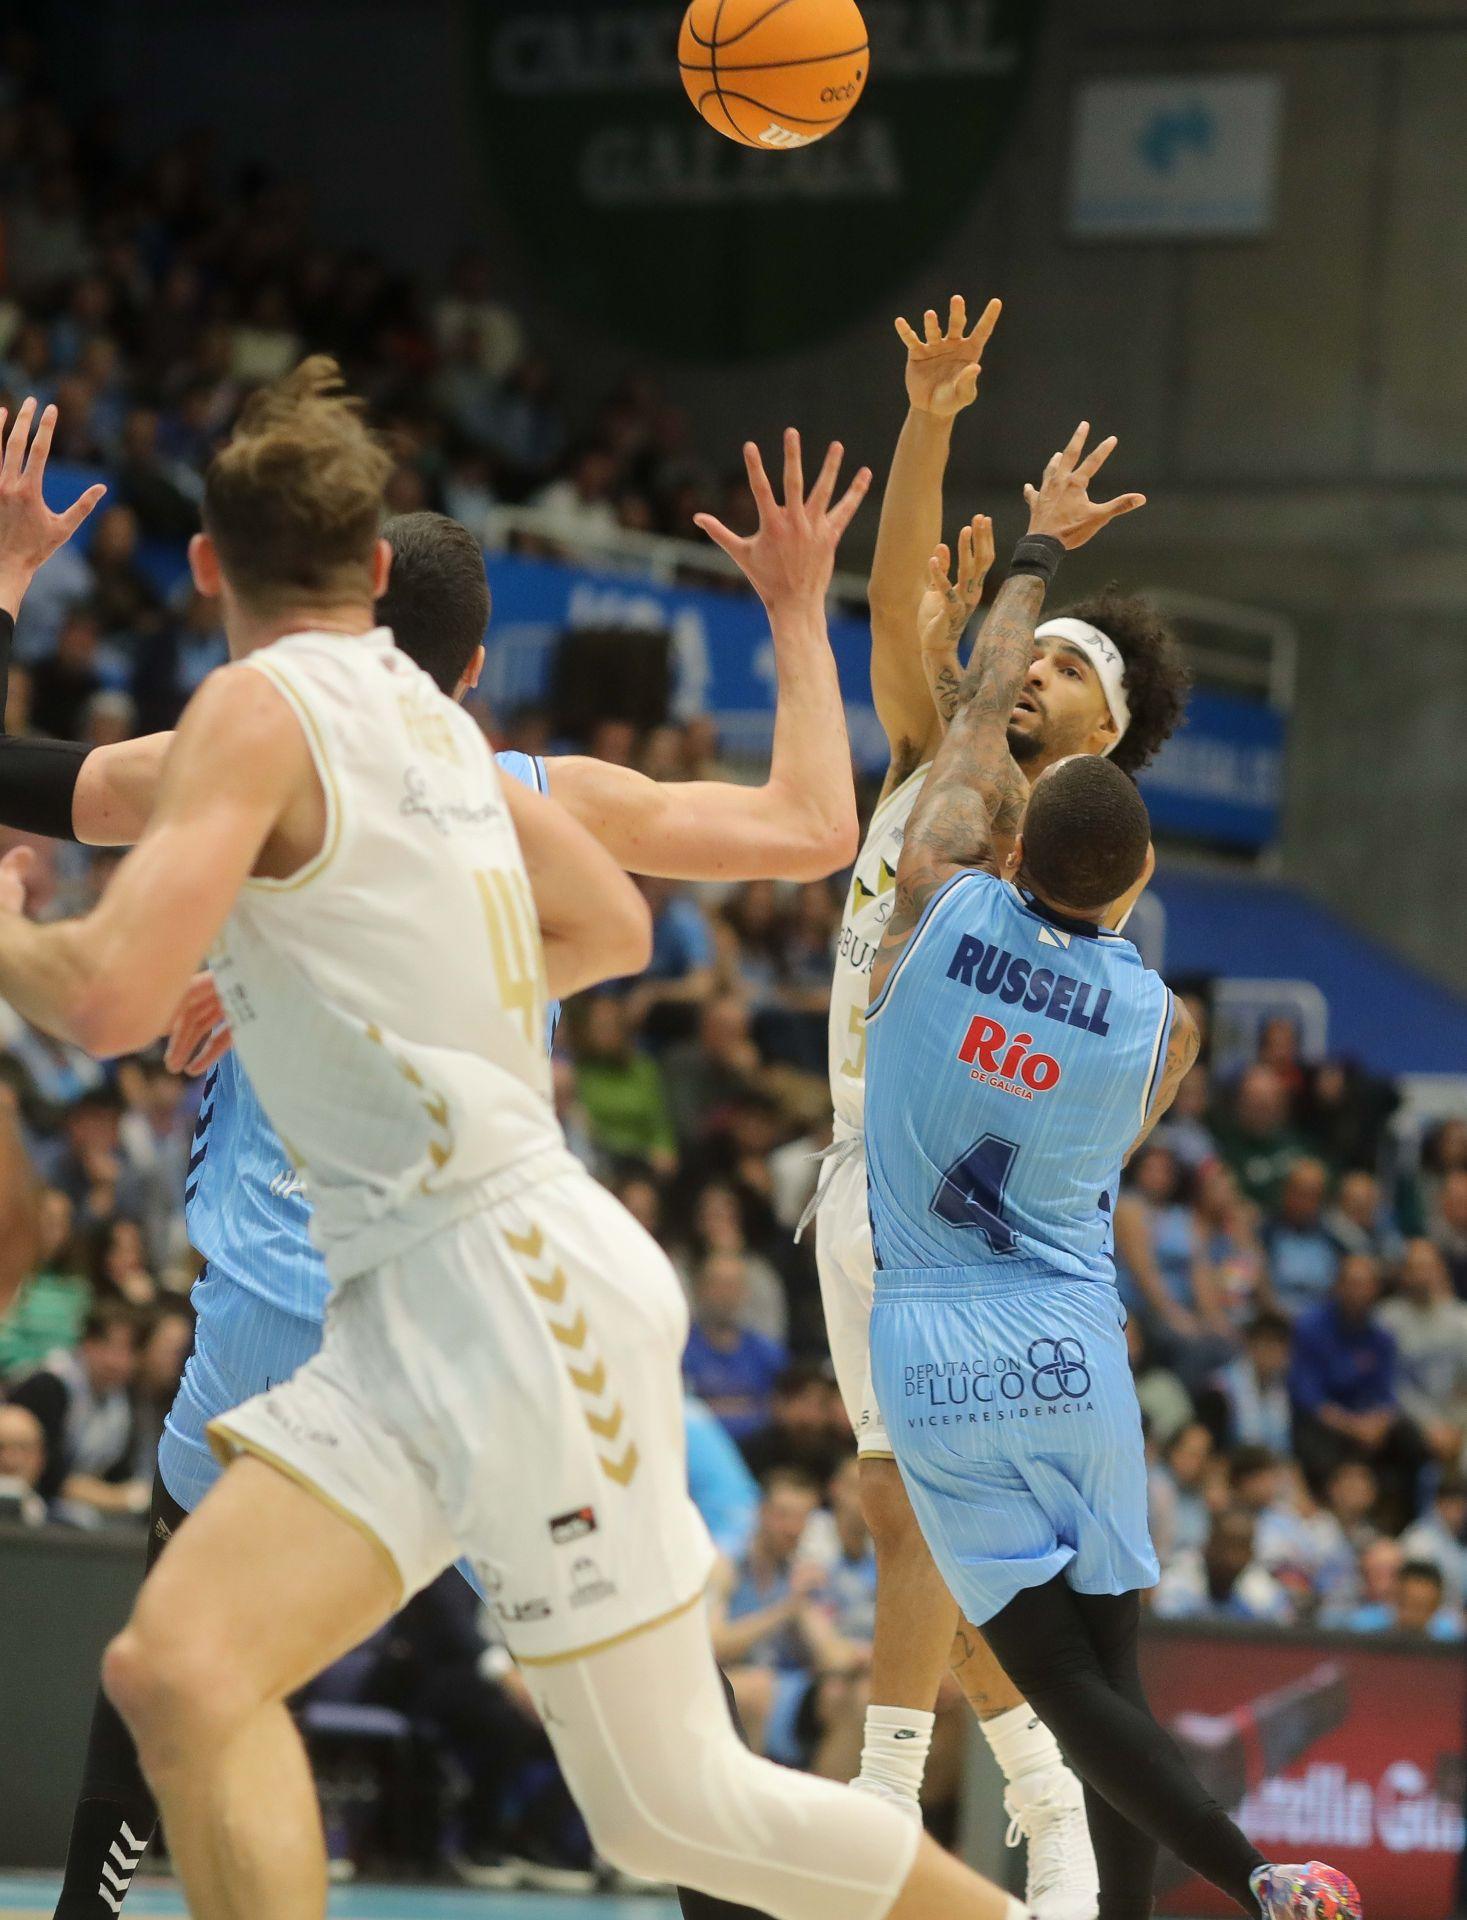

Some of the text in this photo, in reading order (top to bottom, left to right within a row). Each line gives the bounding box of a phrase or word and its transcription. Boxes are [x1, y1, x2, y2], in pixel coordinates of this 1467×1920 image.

[946, 934, 1112, 1037] RUSSELL
[970, 1068, 1034, 1101] DE GALICIA
[928, 1132, 1022, 1256] 4
[904, 1356, 1022, 1382] DEPUTACIÓN
[905, 1379, 925, 1397] DE
[908, 1401, 1095, 1429] VICEPRESIDENCIA
